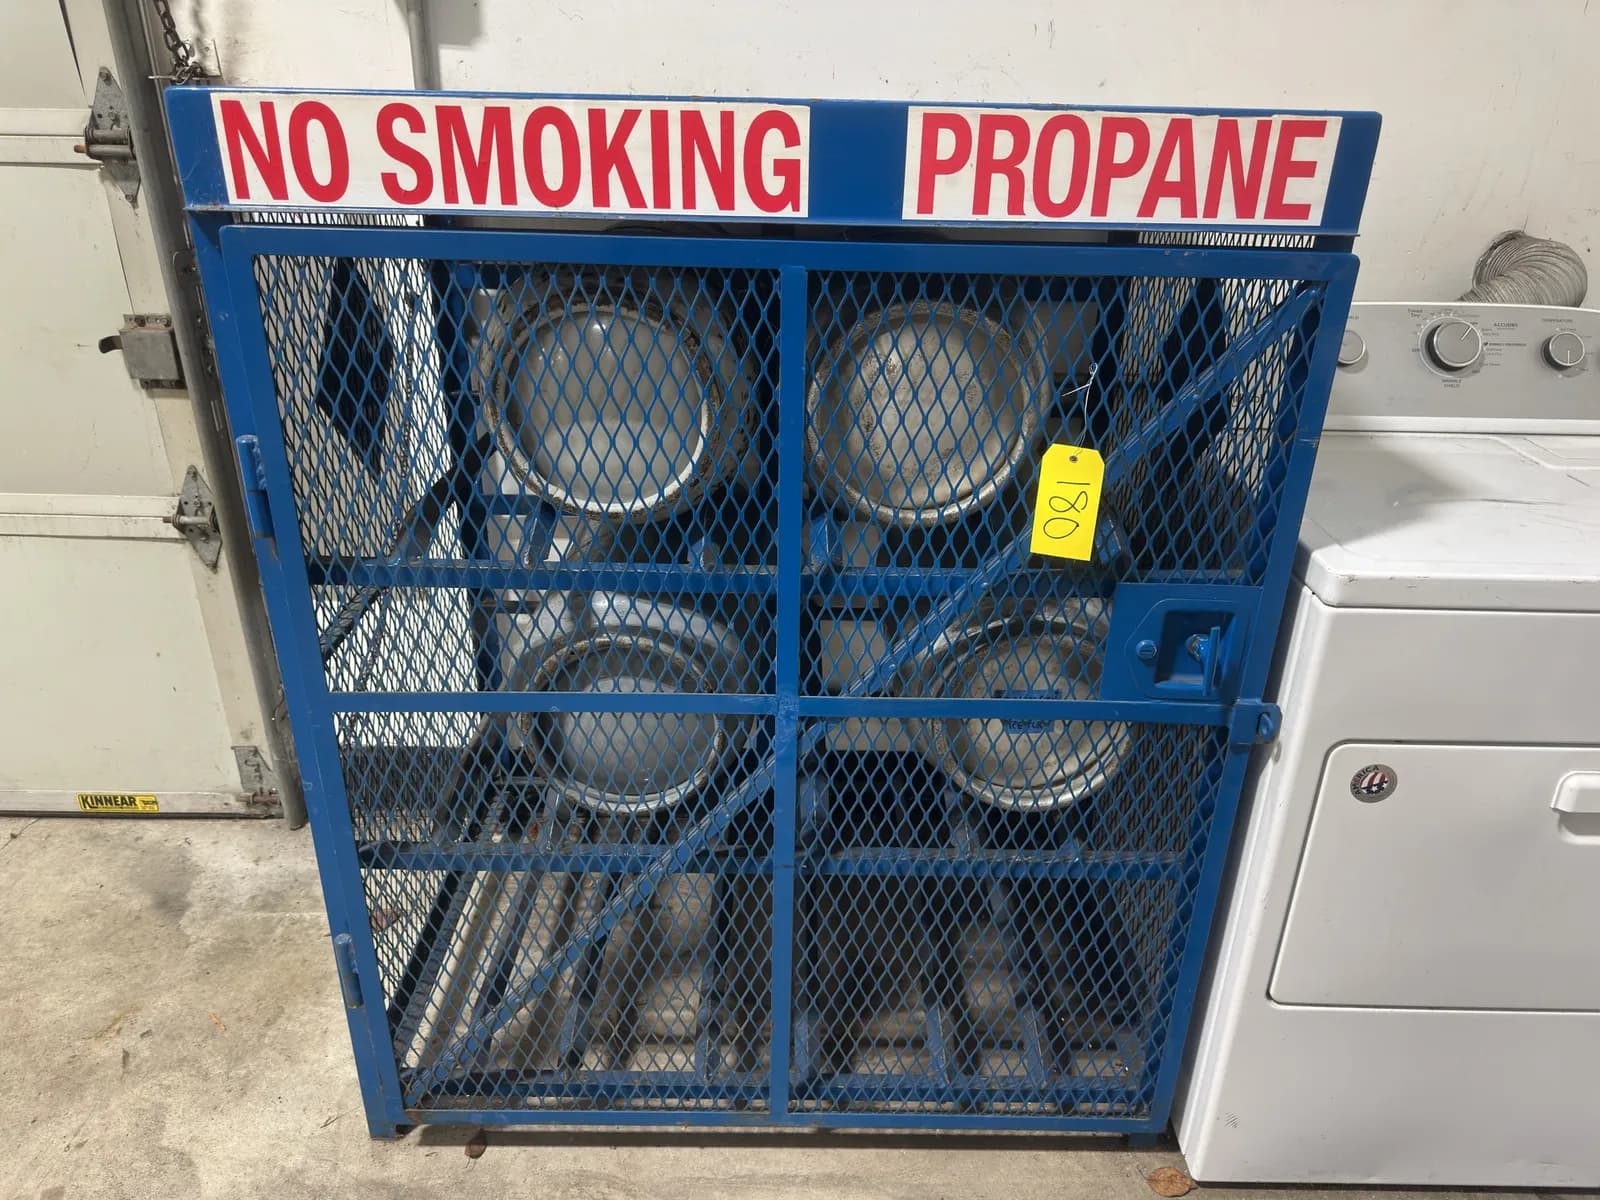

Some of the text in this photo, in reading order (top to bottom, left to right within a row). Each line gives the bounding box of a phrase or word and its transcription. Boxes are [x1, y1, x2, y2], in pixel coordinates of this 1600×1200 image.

[220, 100, 801, 214] NO SMOKING
[917, 112, 1328, 221] PROPANE
[1043, 481, 1091, 540] 180
[81, 795, 137, 808] KINNEAR
